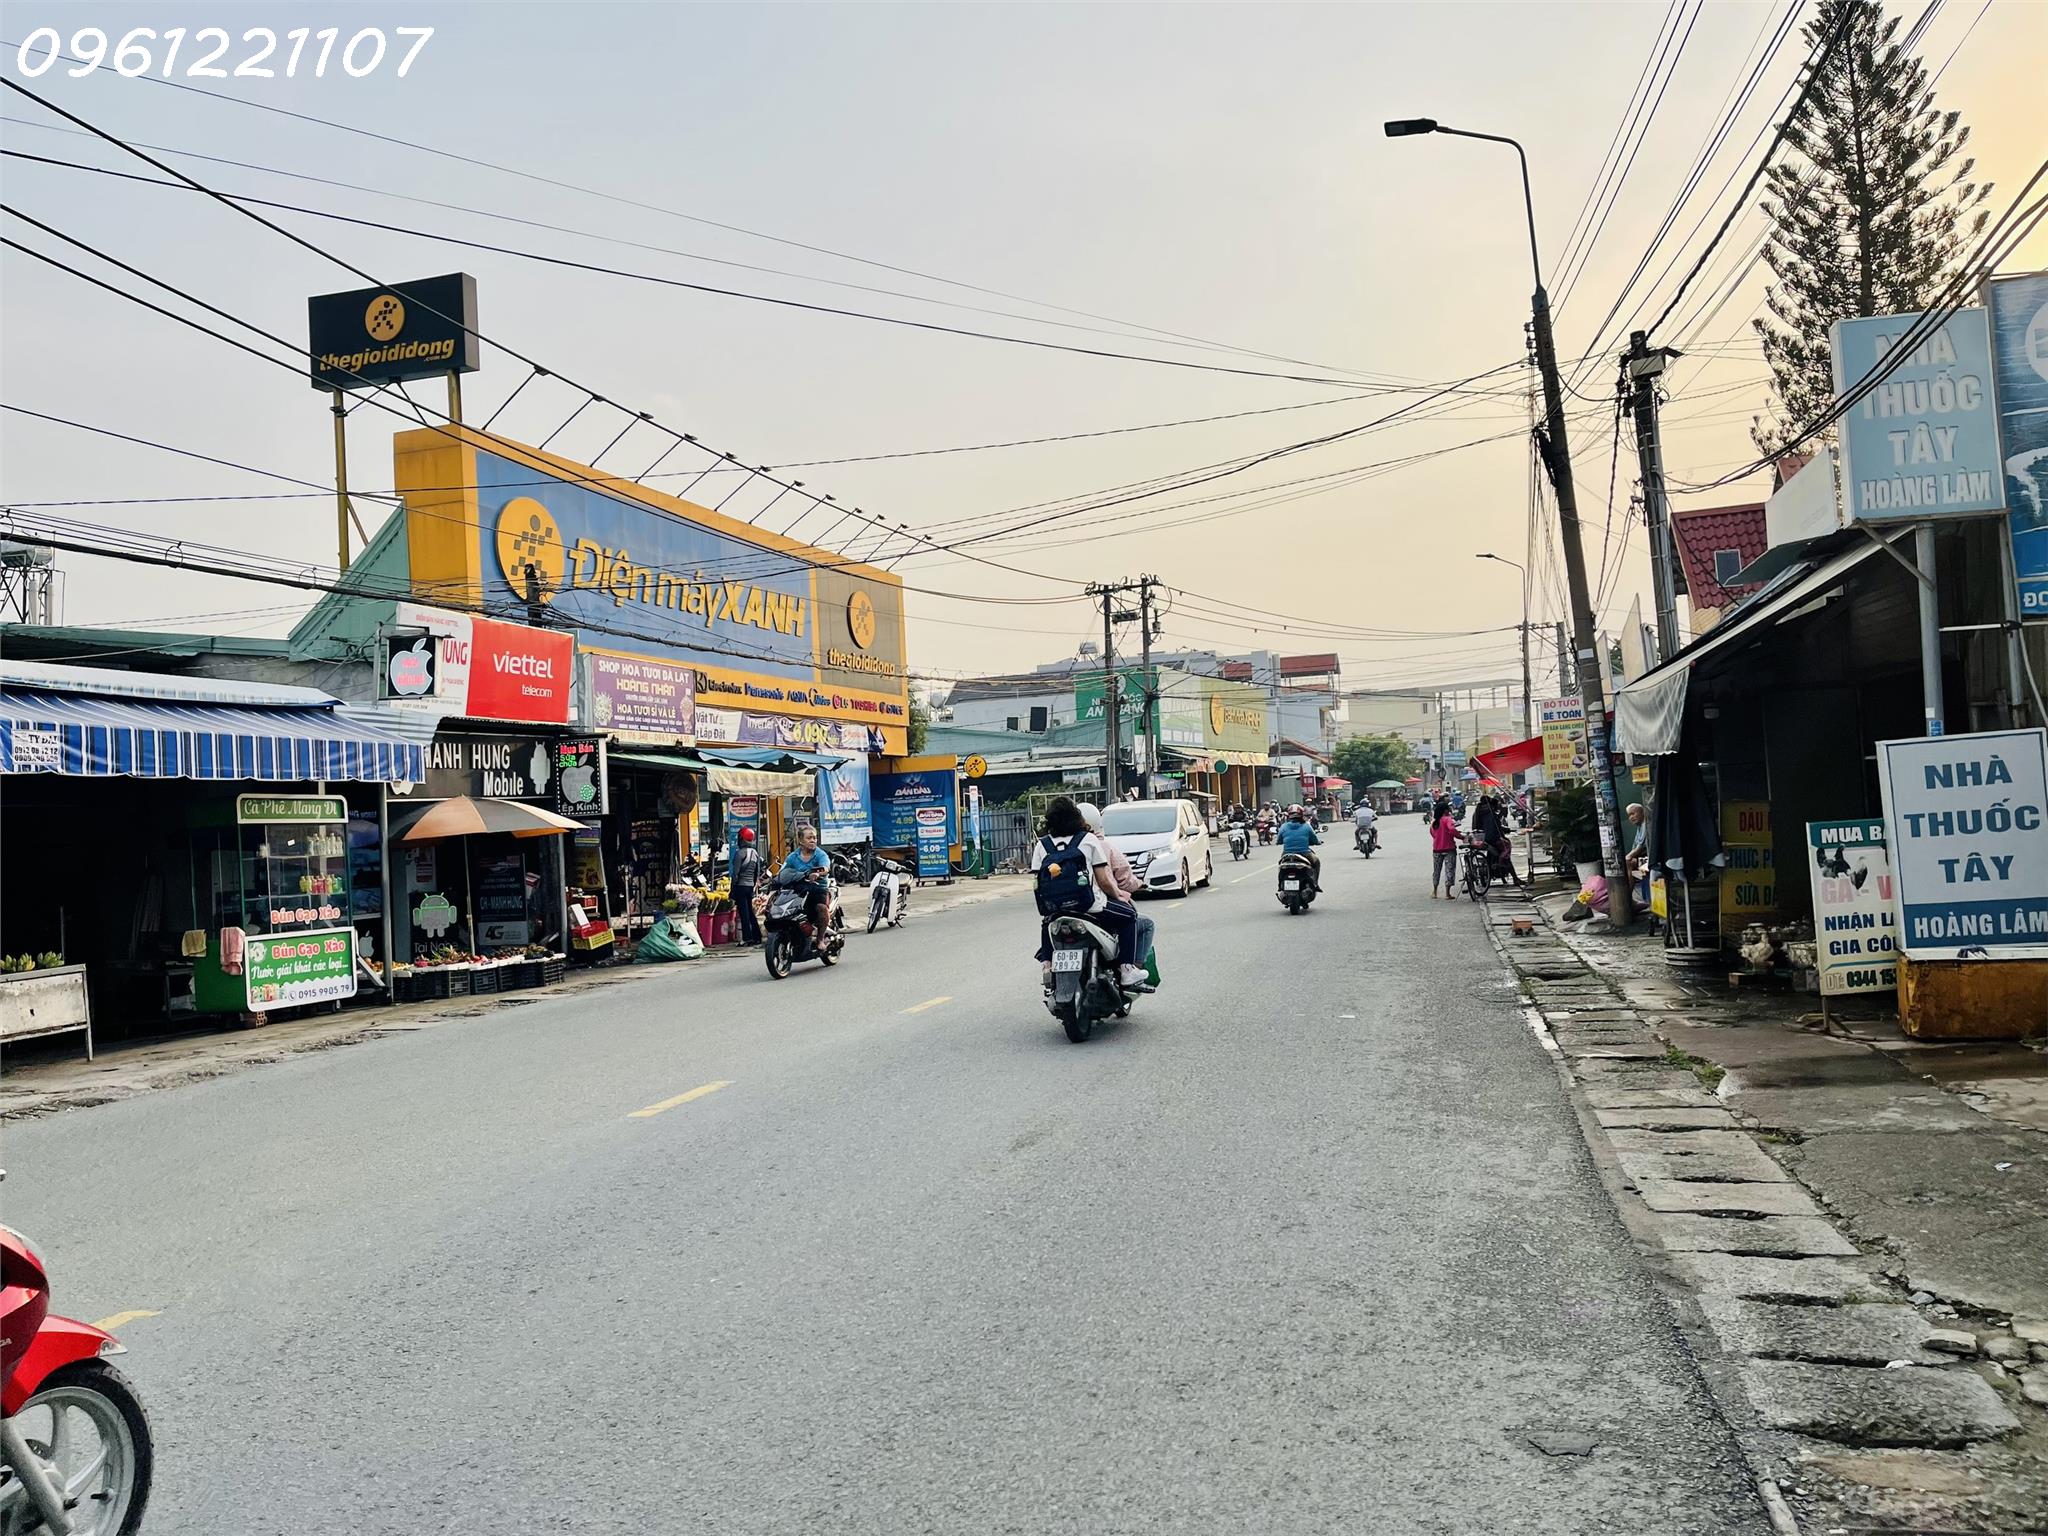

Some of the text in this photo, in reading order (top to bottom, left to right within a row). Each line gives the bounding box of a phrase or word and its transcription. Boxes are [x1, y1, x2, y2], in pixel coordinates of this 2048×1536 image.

[319, 339, 455, 372] thegioididong
[1862, 365, 1983, 420] THUỐC
[1887, 421, 1959, 466] TÂY
[1860, 466, 1993, 511] HOÀNG LÂM
[568, 537, 650, 607] Điện
[493, 650, 553, 679] viettel
[598, 660, 620, 674] SHOP
[621, 663, 640, 677] HOA
[674, 672, 689, 686] LẠT
[828, 647, 896, 679] thegioididong
[521, 684, 553, 698] telecom
[616, 678, 649, 693] HOÀNG
[616, 704, 633, 715] HOA
[658, 706, 668, 719] VÀ
[560, 743, 595, 754] Mua Bán
[1924, 754, 2013, 790] NHÀ
[483, 771, 524, 797] Mobile
[260, 800, 285, 815] Phê
[287, 800, 321, 819] Mang
[576, 801, 598, 812] Kính
[1903, 798, 2040, 838] THUỐC
[1821, 826, 1863, 843] MUA
[1938, 852, 2014, 883] TÂY
[271, 904, 340, 924] Bún Gạo Xào
[1824, 912, 1875, 932] NHẬN
[1914, 908, 2048, 939] HOÀNG LÂM
[485, 926, 504, 940] 4G
[272, 938, 345, 959] Bún Gạo Xào
[414, 943, 427, 953] Tai
[1829, 939, 1861, 955] GIA
[313, 960, 327, 972] các
[1847, 970, 1877, 987] 0344
[298, 984, 350, 999] 0915 9905 79
